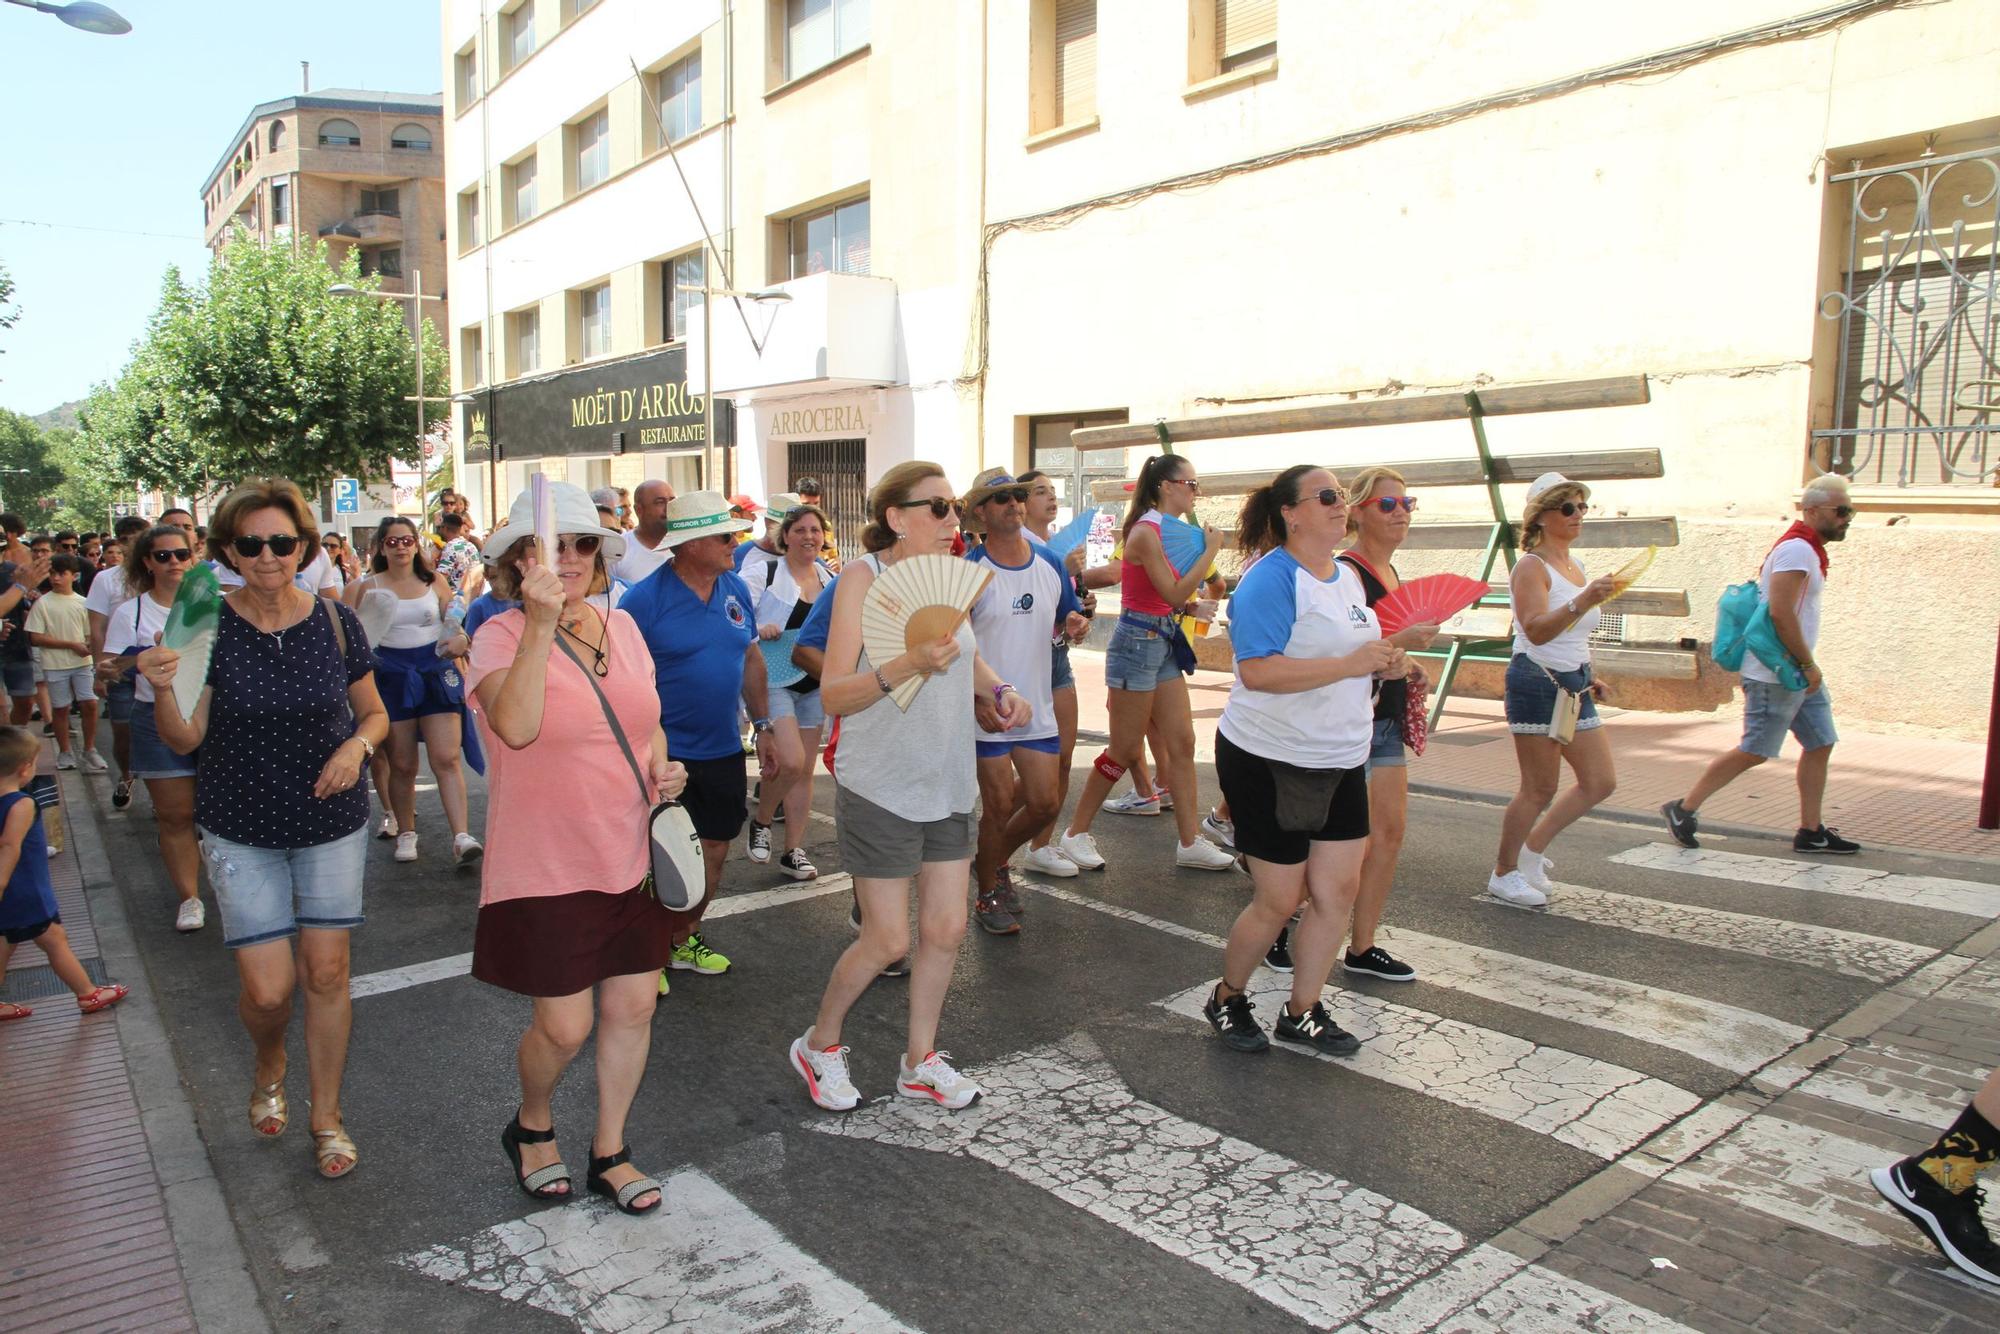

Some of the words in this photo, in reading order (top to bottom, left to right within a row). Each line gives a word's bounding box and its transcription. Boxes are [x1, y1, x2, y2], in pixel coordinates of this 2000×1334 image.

[571, 387, 616, 428] MOËT
[770, 404, 866, 436] ARROCERIA
[640, 423, 706, 445] RESTAURANTE
[336, 481, 352, 500] P
[1302, 1019, 1324, 1038] N
